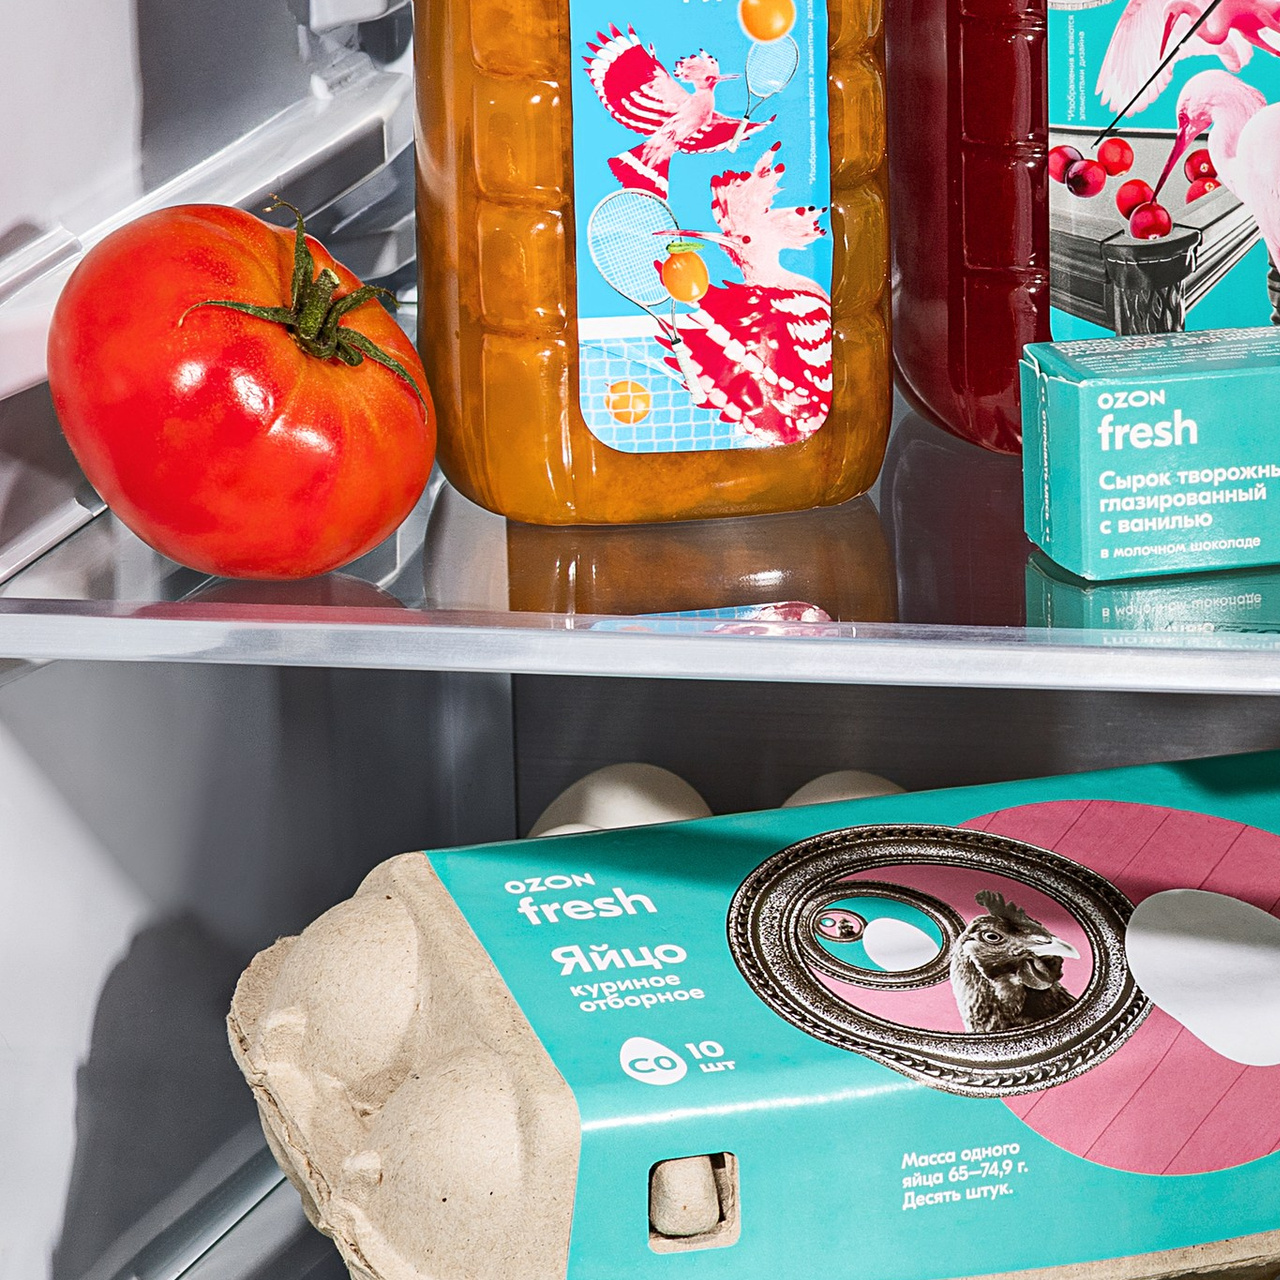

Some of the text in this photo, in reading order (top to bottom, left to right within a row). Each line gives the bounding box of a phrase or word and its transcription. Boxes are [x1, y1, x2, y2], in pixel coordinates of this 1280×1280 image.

[1068, 14, 1076, 55] являются
[1078, 31, 1087, 122] элементами дизайна
[1098, 390, 1165, 409] OZON
[1098, 408, 1197, 451] fresh
[1099, 470, 1172, 493] Сырок
[1099, 483, 1266, 513] глазированный
[1100, 512, 1213, 534] с ванилью
[1101, 537, 1261, 558] в молочном шоколаде
[504, 872, 595, 895] OZON
[517, 886, 657, 926] fresh
[551, 943, 687, 976] Яйцо
[569, 973, 681, 999] куриное
[579, 987, 706, 1013] отборное
[685, 1041, 724, 1059] 10
[698, 1060, 736, 1073] шт
[901, 1142, 1020, 1170] Масса одного
[902, 1172, 944, 1189] яйца
[1018, 1162, 1028, 1173] г.
[902, 1184, 1013, 1210] Десять штук.
